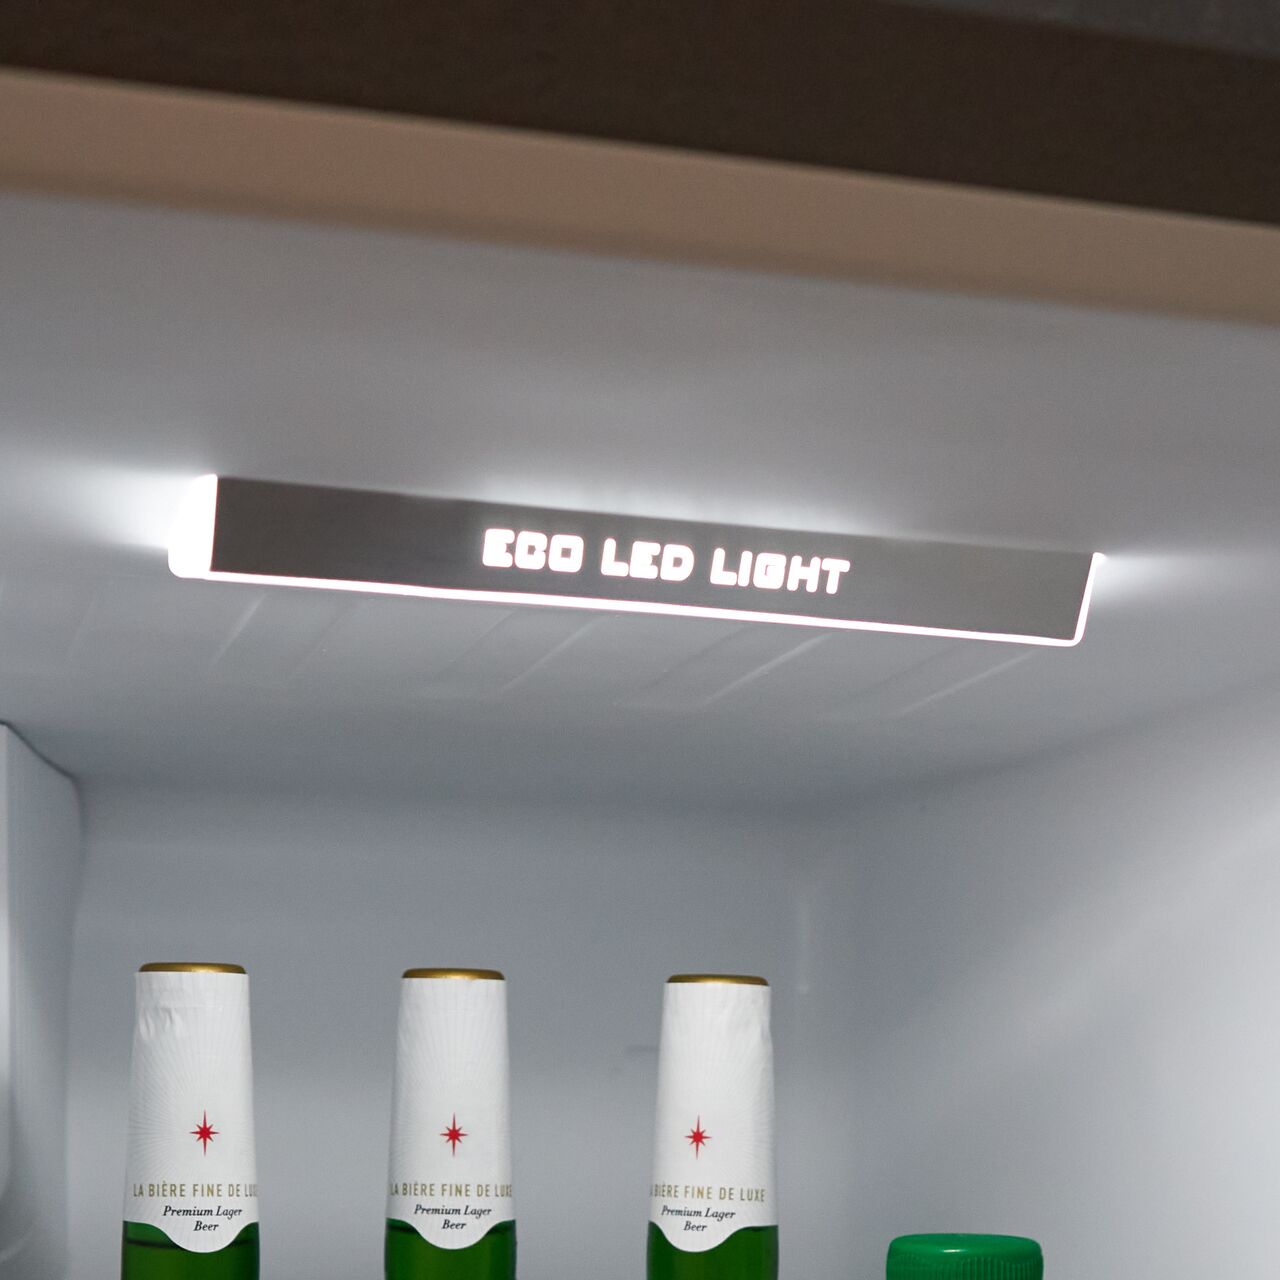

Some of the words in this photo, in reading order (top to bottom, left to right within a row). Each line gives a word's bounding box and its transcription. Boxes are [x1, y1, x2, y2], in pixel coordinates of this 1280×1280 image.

[482, 528, 584, 573] ECO
[600, 537, 695, 582] LED
[709, 547, 851, 595] LIGHT
[192, 1183, 223, 1198] FINE
[228, 1183, 241, 1198] DE
[441, 1183, 471, 1198] FINE
[477, 1184, 491, 1198] DE
[684, 1185, 713, 1200] FINE
[719, 1187, 735, 1201] DE
[740, 1187, 766, 1202] LUXE
[162, 1205, 213, 1217] Premium
[216, 1205, 243, 1220] Lager
[414, 1203, 461, 1216] Premium
[463, 1205, 492, 1219] Lager
[661, 1204, 702, 1218] Premium
[704, 1207, 736, 1222] Lager
[193, 1220, 219, 1232] Beer
[441, 1219, 467, 1230] Beer
[683, 1220, 708, 1232] Beer
